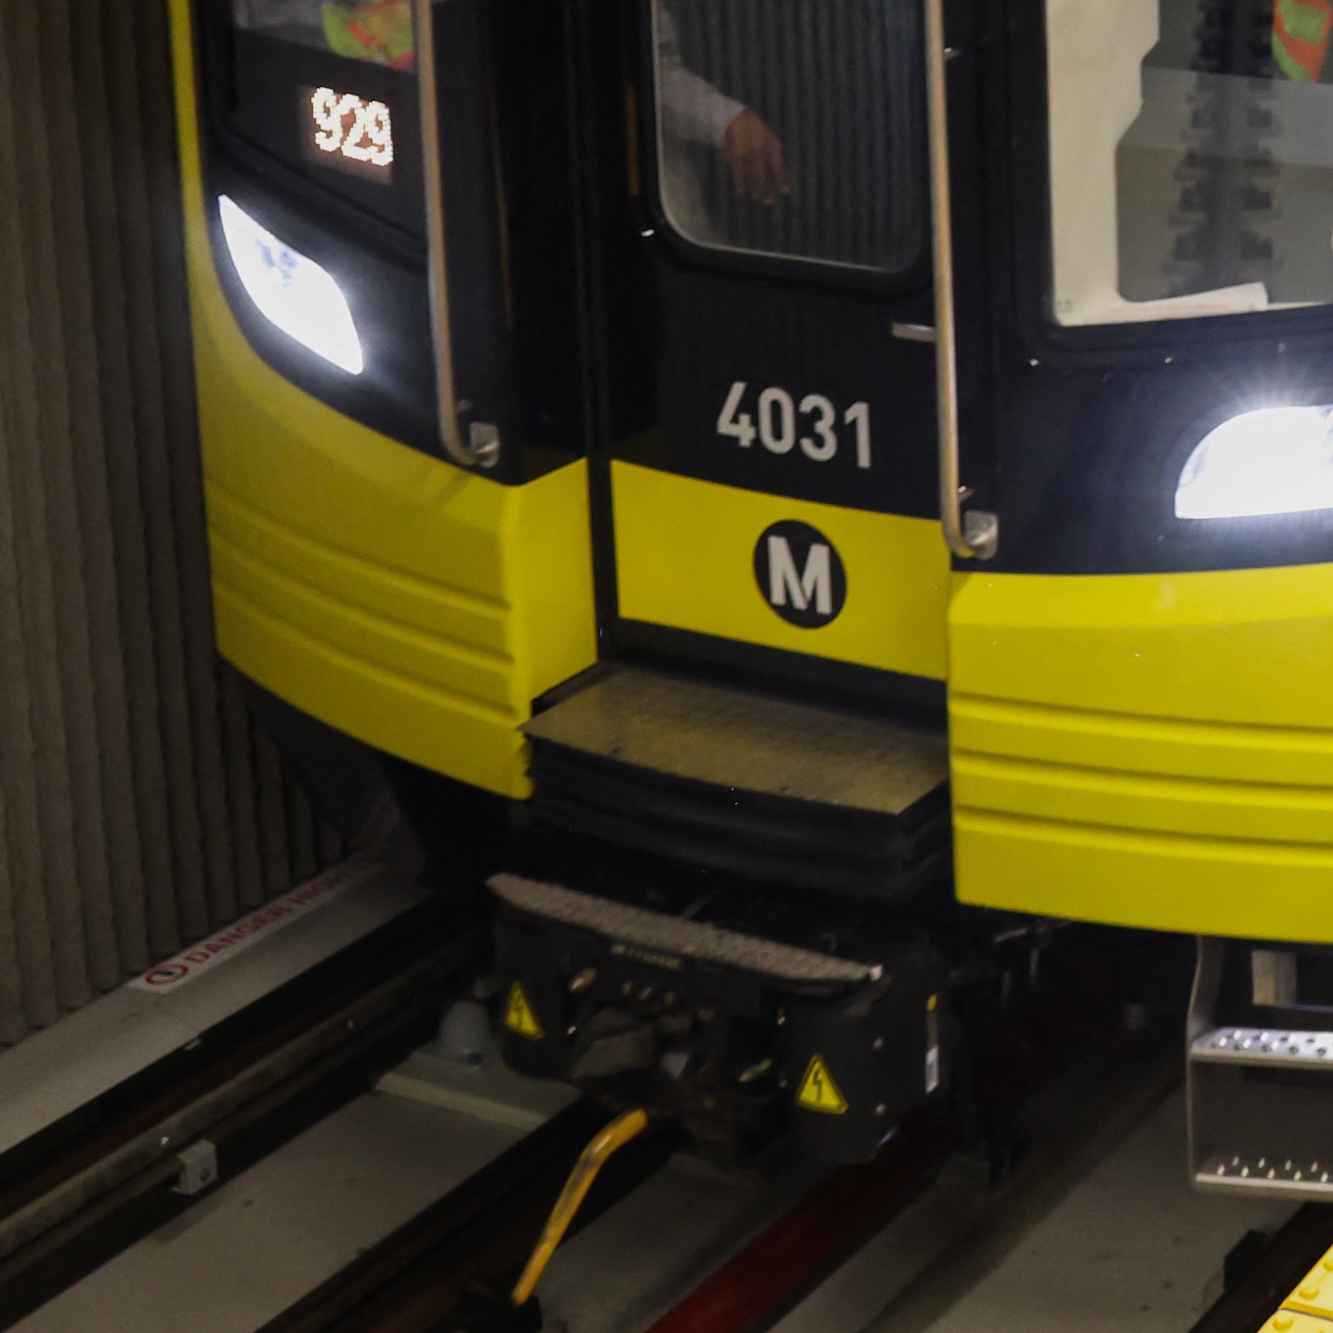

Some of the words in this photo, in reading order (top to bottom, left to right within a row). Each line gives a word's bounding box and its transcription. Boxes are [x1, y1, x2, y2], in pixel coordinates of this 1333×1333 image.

[311, 86, 394, 166] 929
[716, 381, 870, 469] 4031
[767, 534, 833, 615] M
